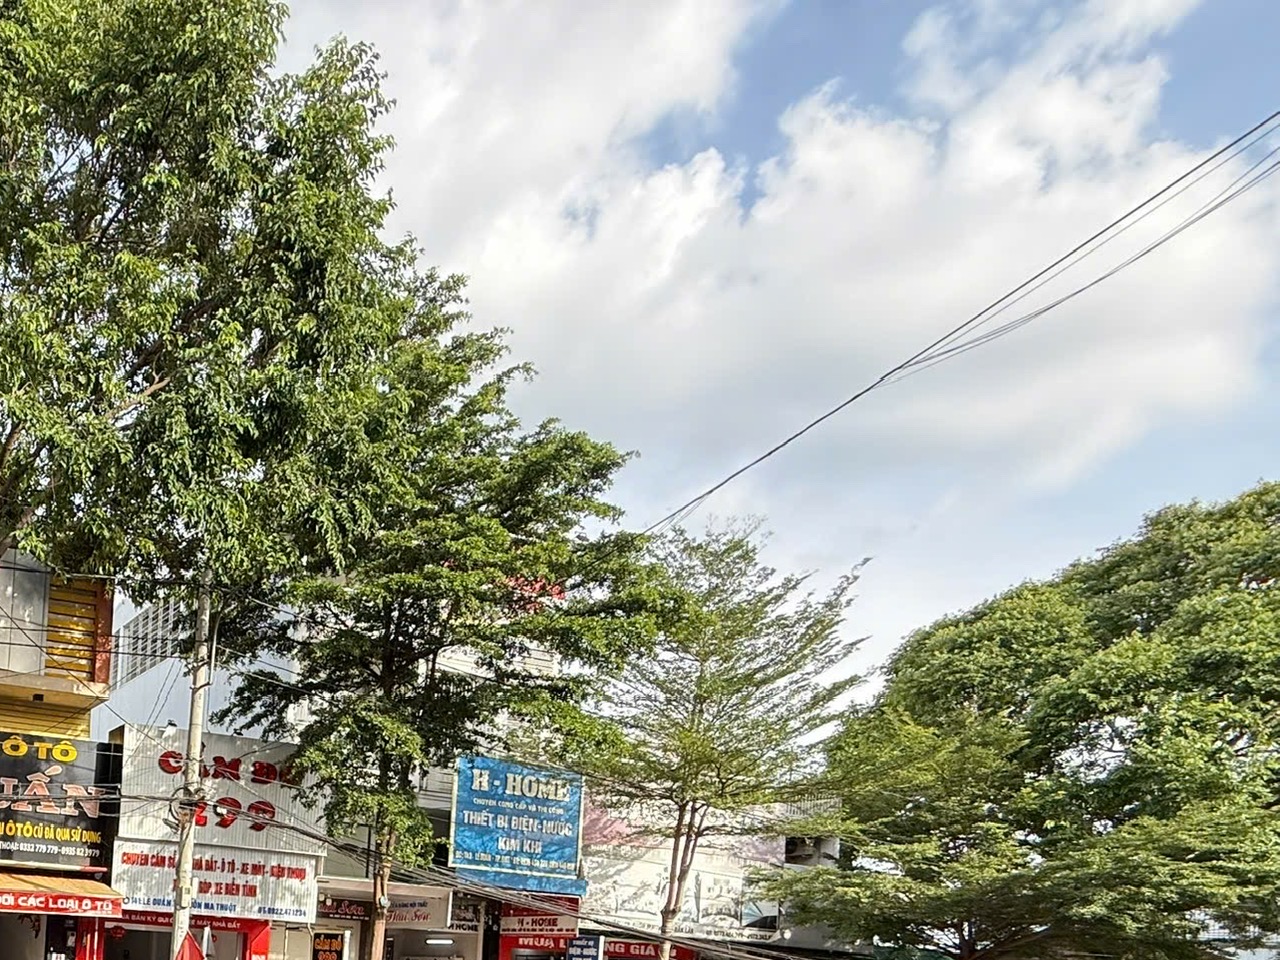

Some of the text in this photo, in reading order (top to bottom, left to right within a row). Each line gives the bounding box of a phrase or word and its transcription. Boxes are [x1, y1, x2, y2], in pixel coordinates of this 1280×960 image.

[2, 735, 28, 756] Ô
[34, 740, 78, 762] TÔ
[158, 742, 242, 782] CM
[472, 768, 570, 802] H HOME
[463, 808, 494, 826] THIẾT
[496, 814, 508, 832] BỊ
[56, 828, 70, 842] QUA
[71, 826, 82, 842] SỬ
[82, 830, 102, 844] DỤNG
[498, 836, 520, 852] KIM
[240, 862, 250, 874] XE
[214, 882, 223, 895] XE
[18, 895, 45, 908] CÁC
[48, 897, 79, 911] LOẠI
[96, 898, 113, 912] TÔ
[204, 902, 214, 910] MA
[216, 902, 236, 914] THUỘT
[630, 941, 656, 956] GIÁ
